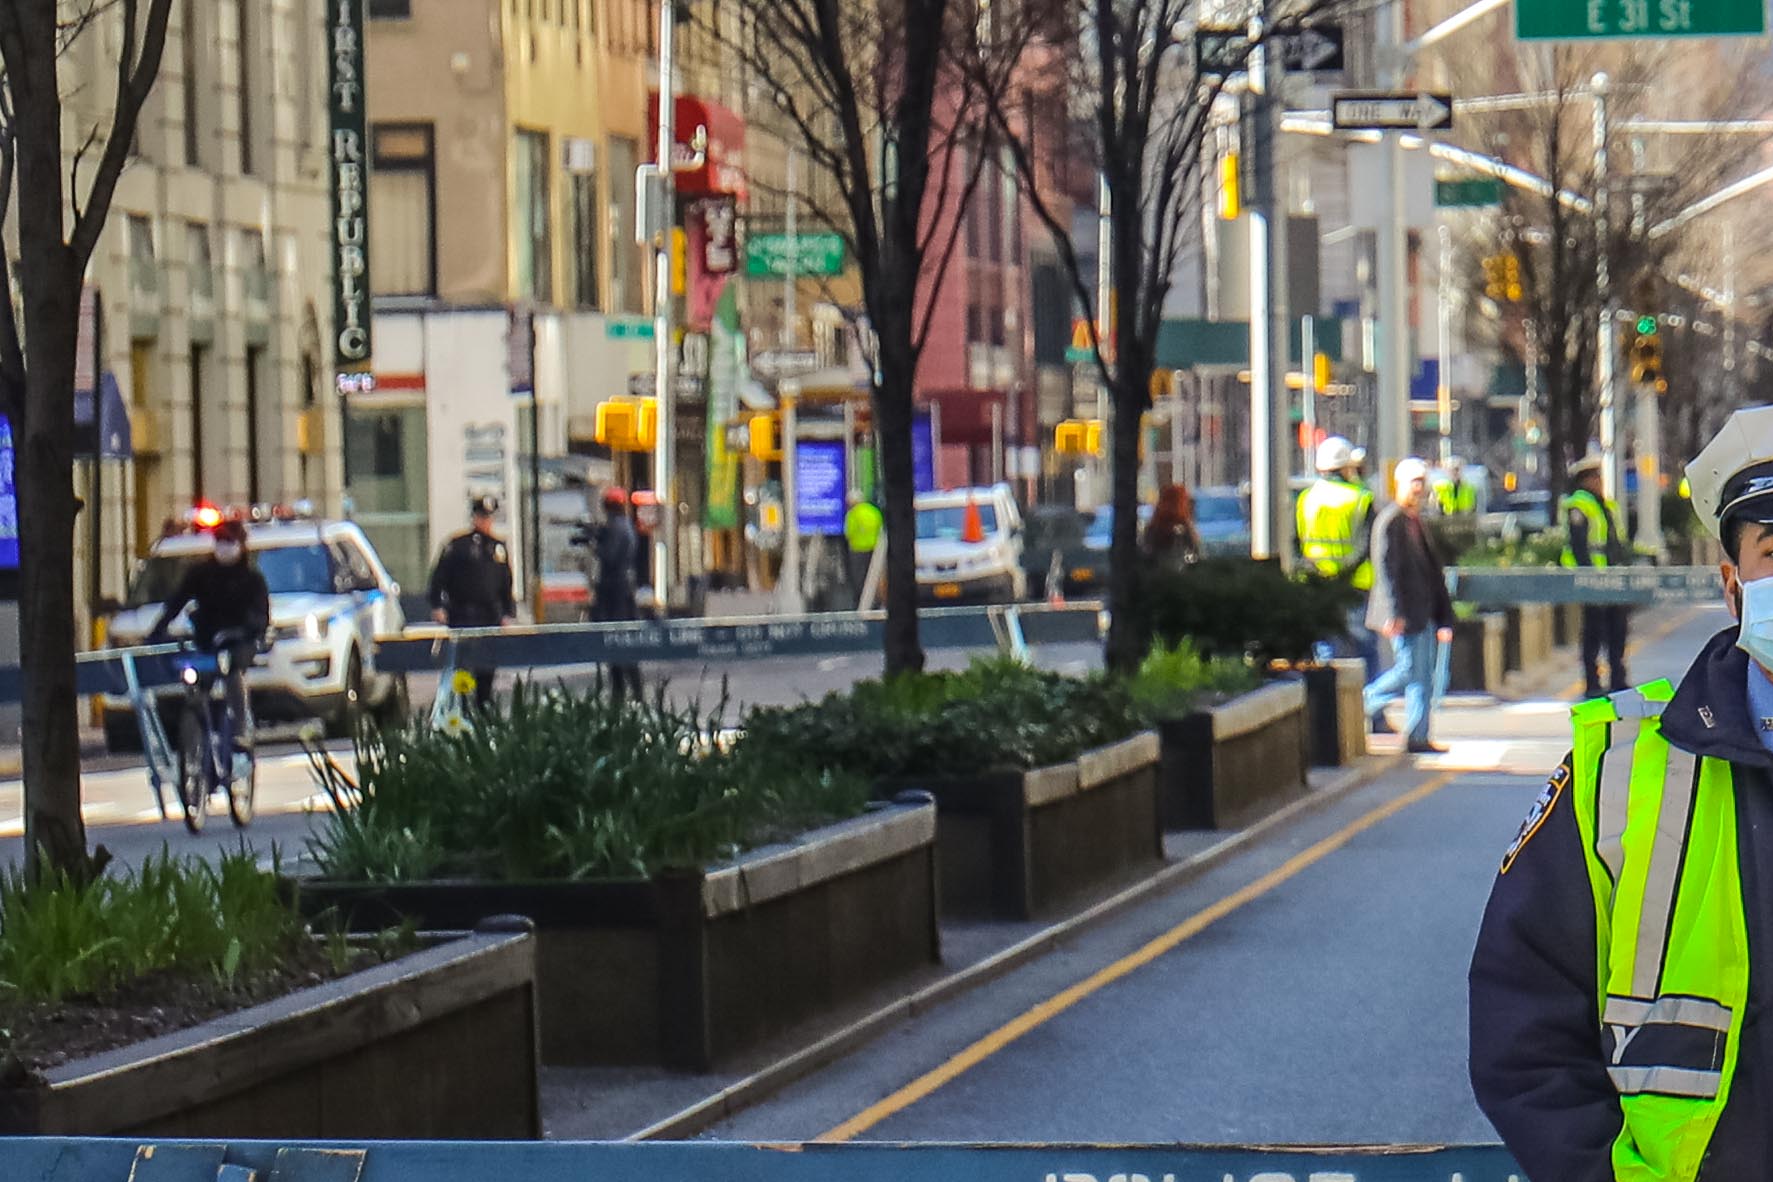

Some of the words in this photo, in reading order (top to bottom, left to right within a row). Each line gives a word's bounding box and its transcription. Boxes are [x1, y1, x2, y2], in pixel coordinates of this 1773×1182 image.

[333, 0, 360, 112] IRST
[1588, 0, 1606, 33] E
[1618, 0, 1649, 32] 31
[1659, 0, 1692, 31] St
[334, 129, 367, 360] REPUBLIC
